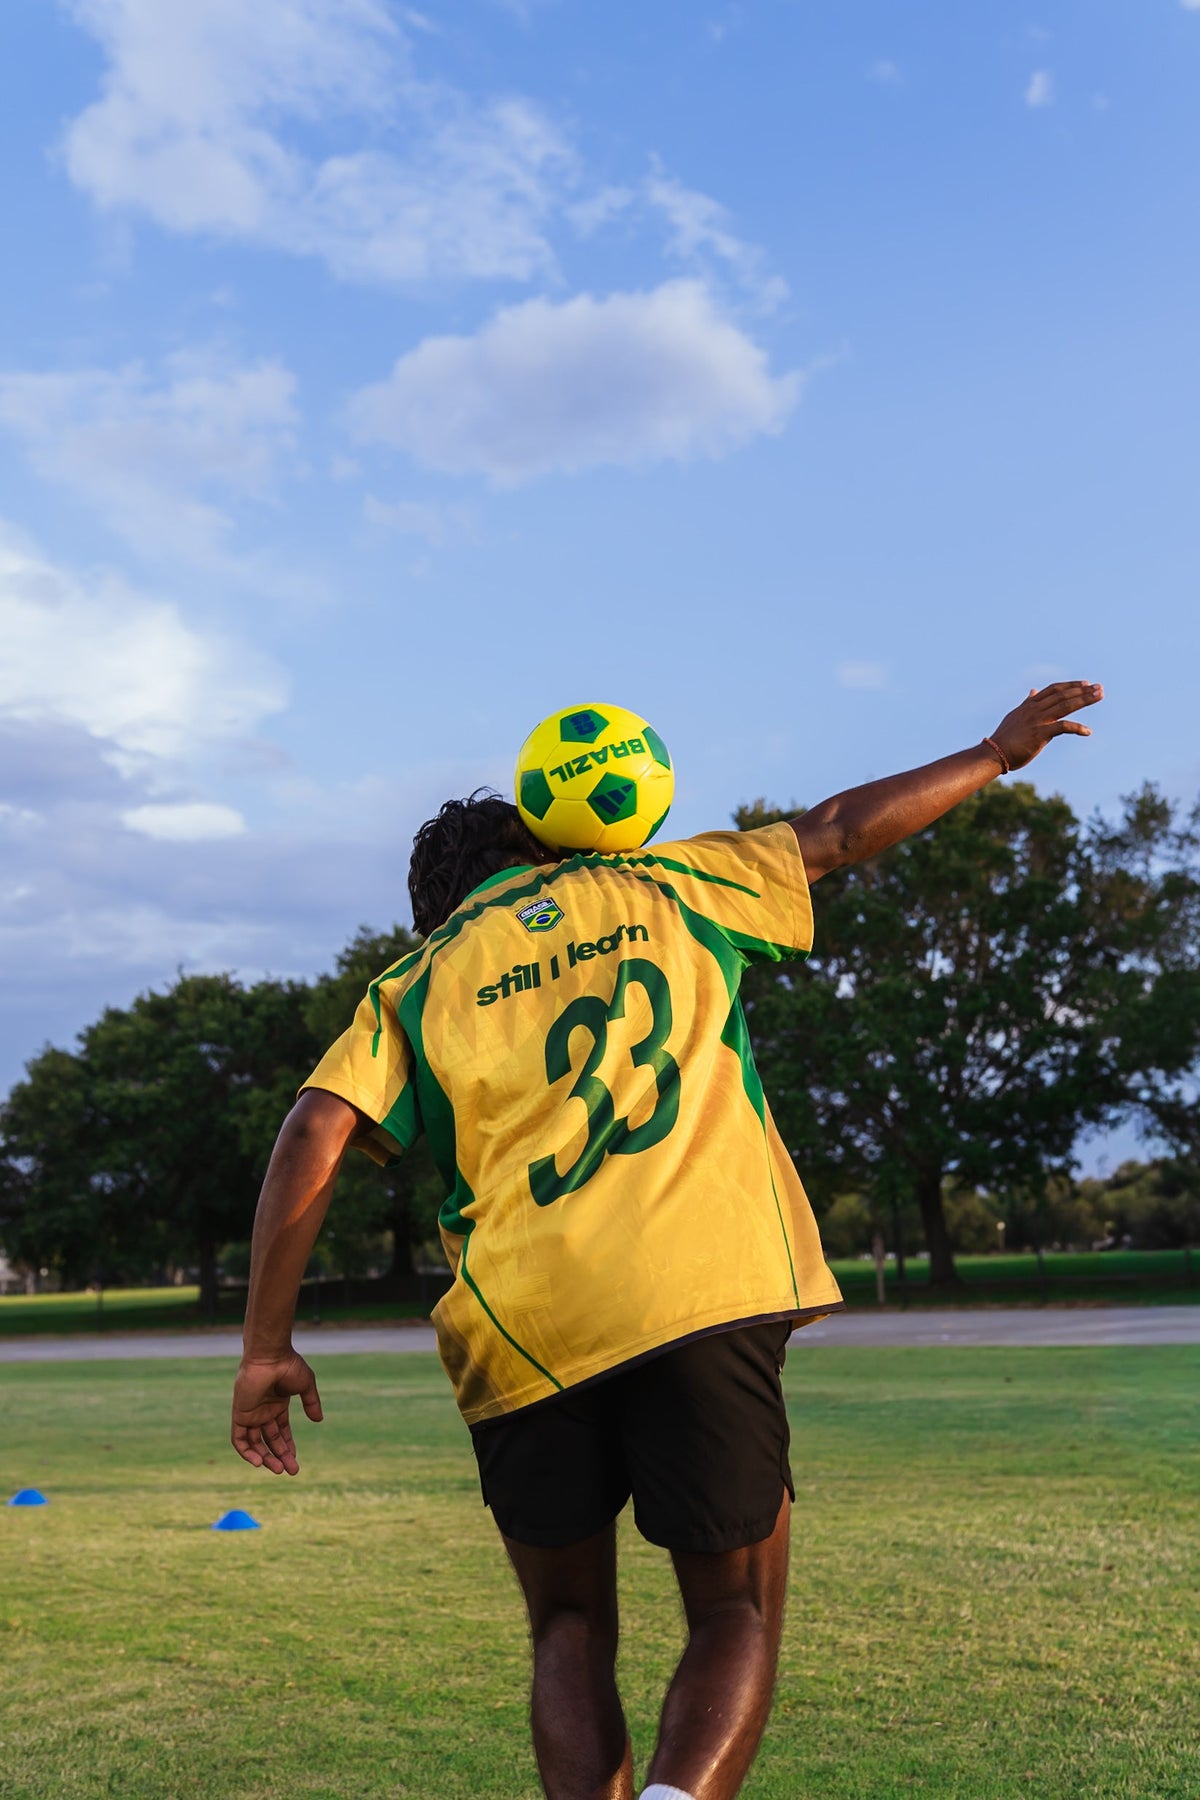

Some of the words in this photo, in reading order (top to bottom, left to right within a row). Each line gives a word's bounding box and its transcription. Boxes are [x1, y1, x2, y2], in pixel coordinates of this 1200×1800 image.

[549, 738, 646, 783] BRAZIL
[520, 900, 552, 918] BRASIL
[476, 962, 541, 1007] still
[566, 924, 649, 969] learn
[528, 958, 681, 1207] 33
